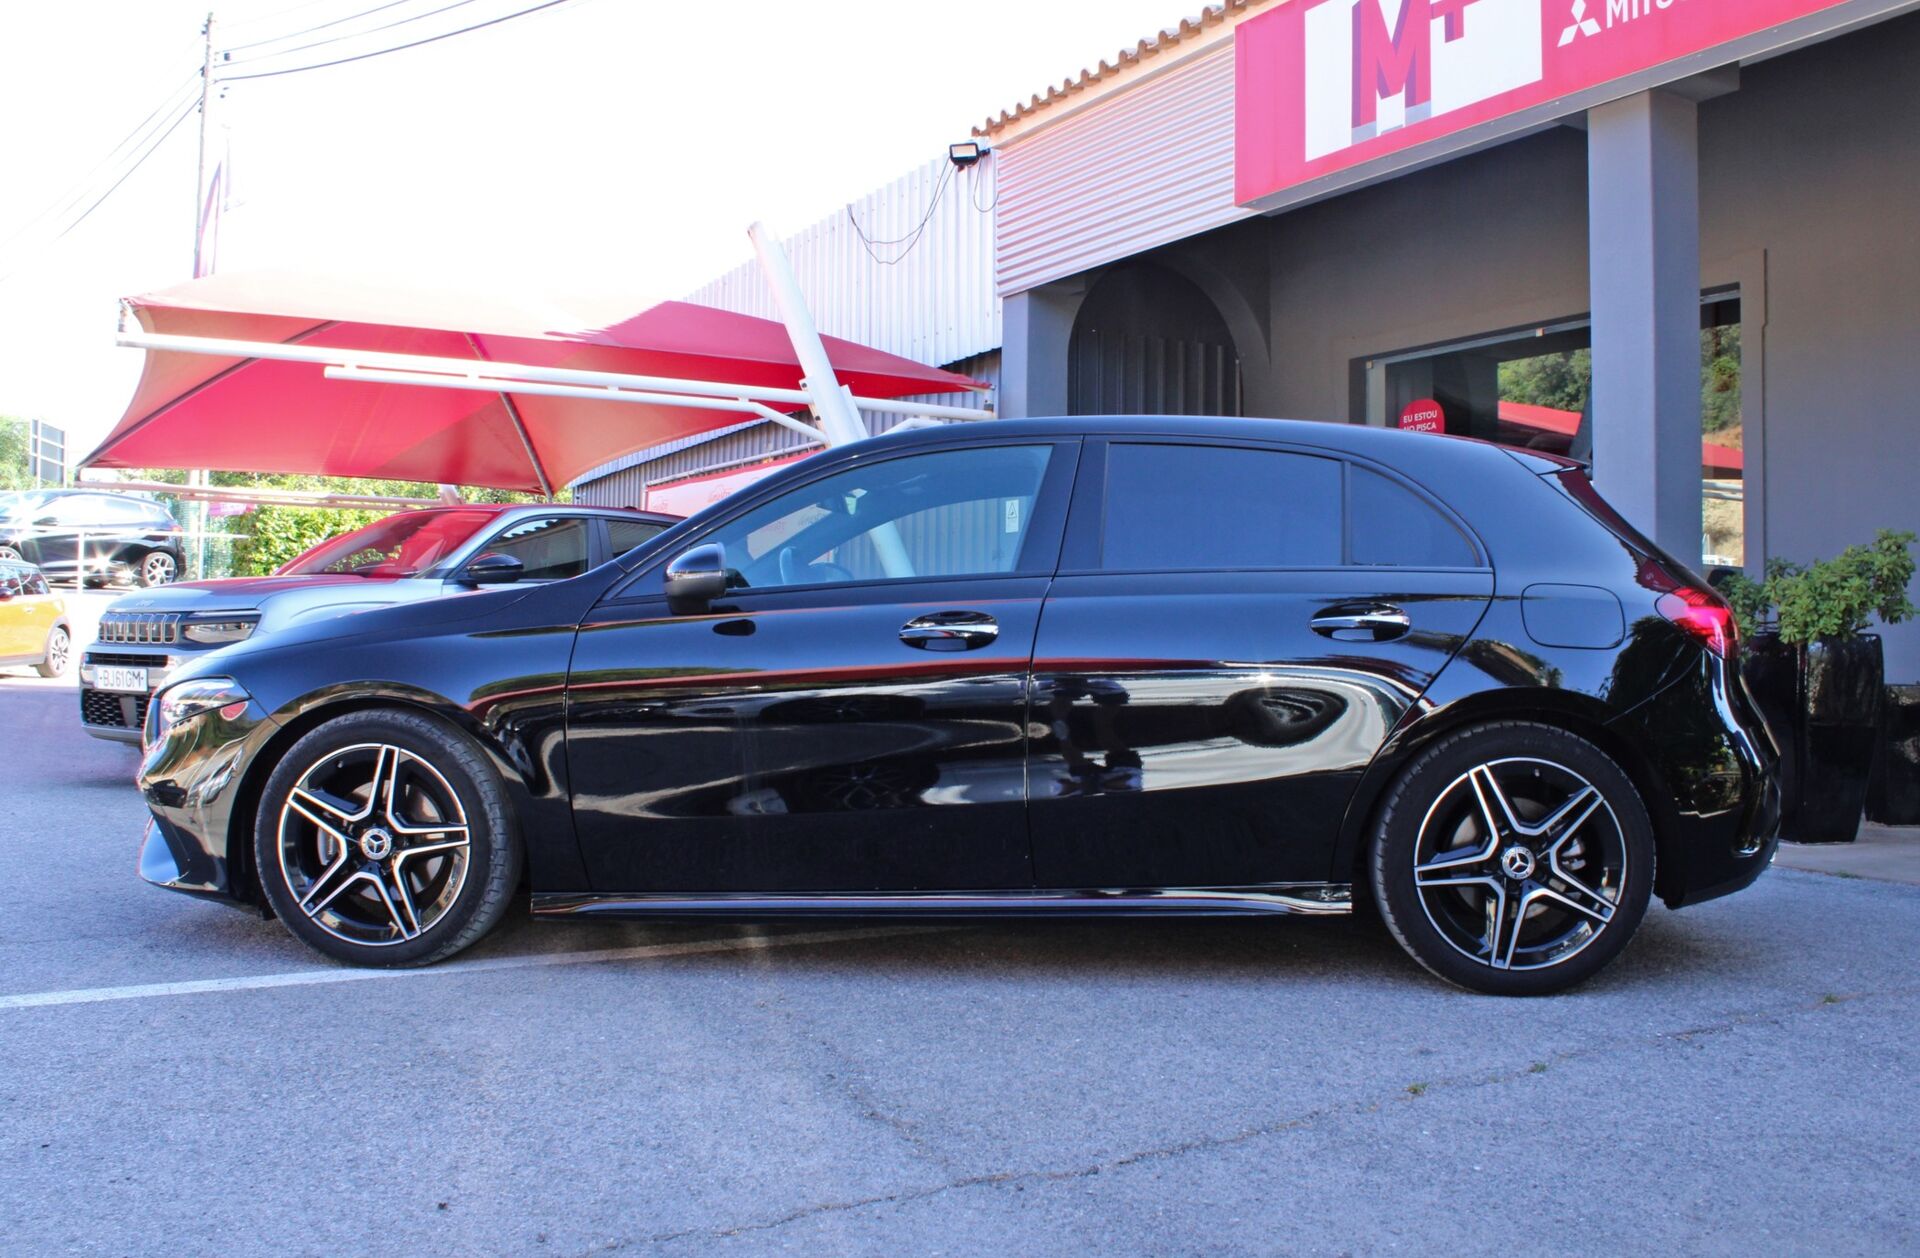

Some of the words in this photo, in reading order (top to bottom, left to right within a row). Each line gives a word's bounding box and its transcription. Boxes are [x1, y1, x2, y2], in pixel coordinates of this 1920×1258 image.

[1403, 415, 1413, 423] EU
[1414, 410, 1437, 421] ESTOU
[1416, 421, 1437, 432] PISCA
